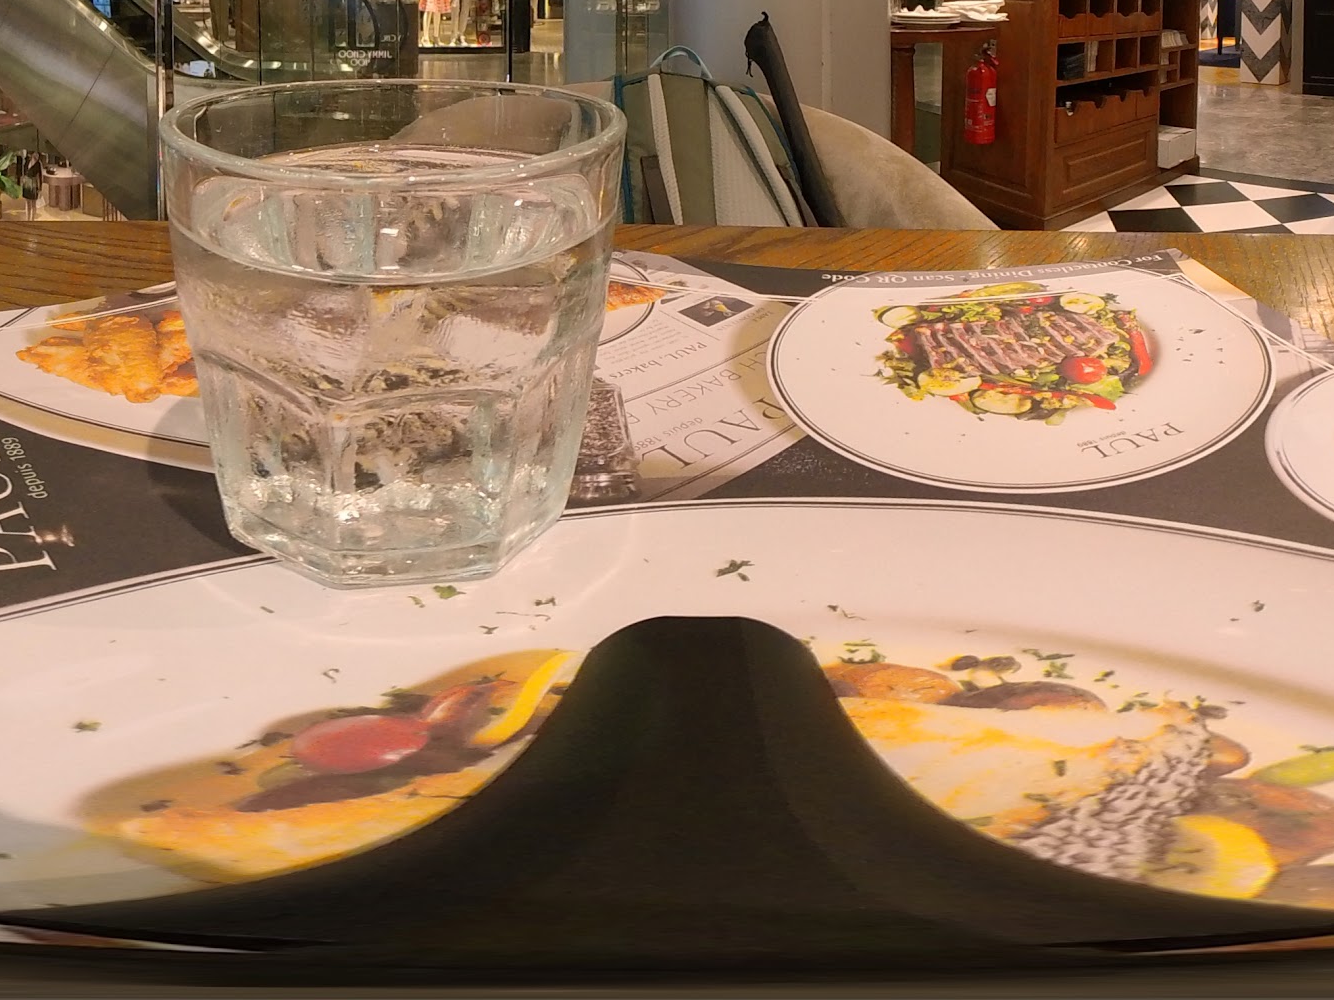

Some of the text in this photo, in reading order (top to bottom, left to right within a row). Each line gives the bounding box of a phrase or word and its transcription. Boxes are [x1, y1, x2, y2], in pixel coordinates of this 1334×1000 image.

[1038, 257, 1133, 276] Contactless
[1133, 253, 1163, 264] For
[821, 273, 870, 285] Code
[875, 272, 908, 285] QR
[912, 272, 955, 284] Scan
[969, 267, 1034, 282] Dining
[609, 359, 657, 380] bakers
[646, 368, 742, 416] BAKERY
[641, 397, 787, 468] PAUL
[662, 417, 703, 436] depuis
[1081, 422, 1184, 458] PAUL
[1, 437, 48, 499] depuis 1889
